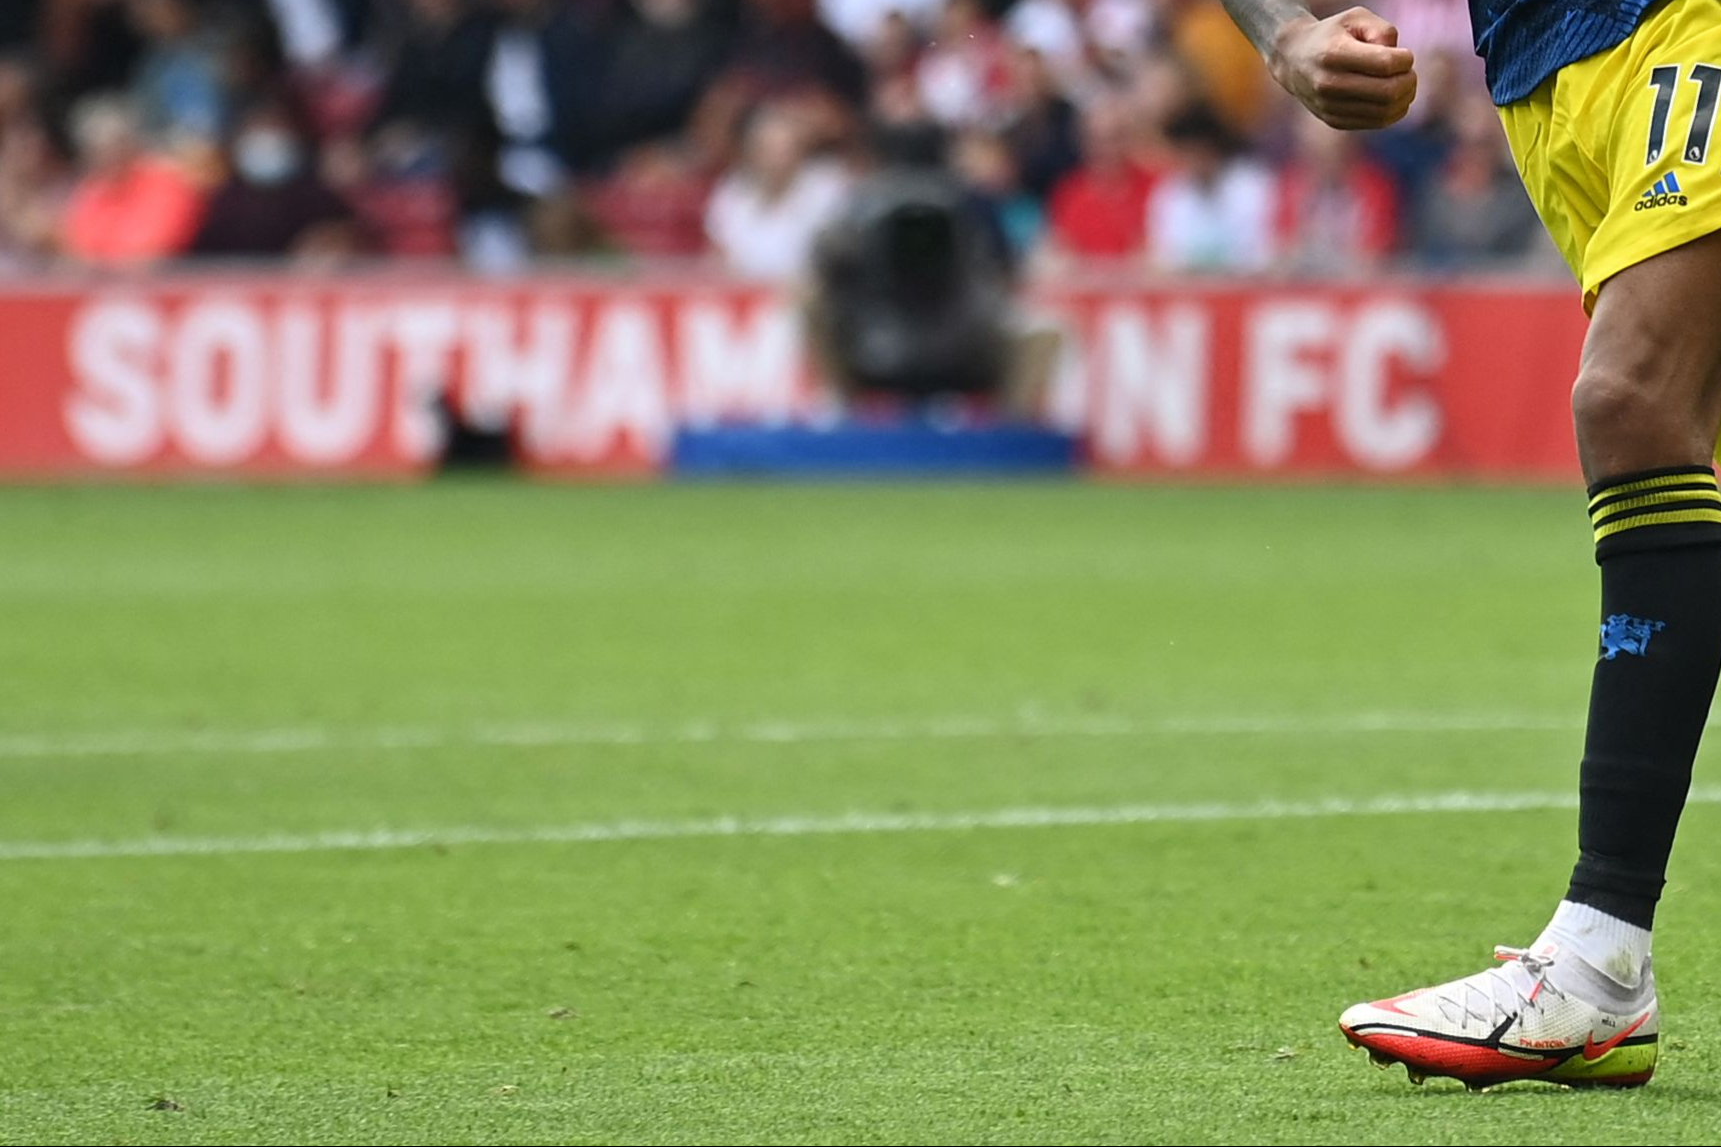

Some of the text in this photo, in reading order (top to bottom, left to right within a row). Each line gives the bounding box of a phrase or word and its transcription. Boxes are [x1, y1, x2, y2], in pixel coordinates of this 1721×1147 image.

[1634, 193, 1688, 211] adidas
[66, 295, 1448, 468] SOUTHAMN FC
